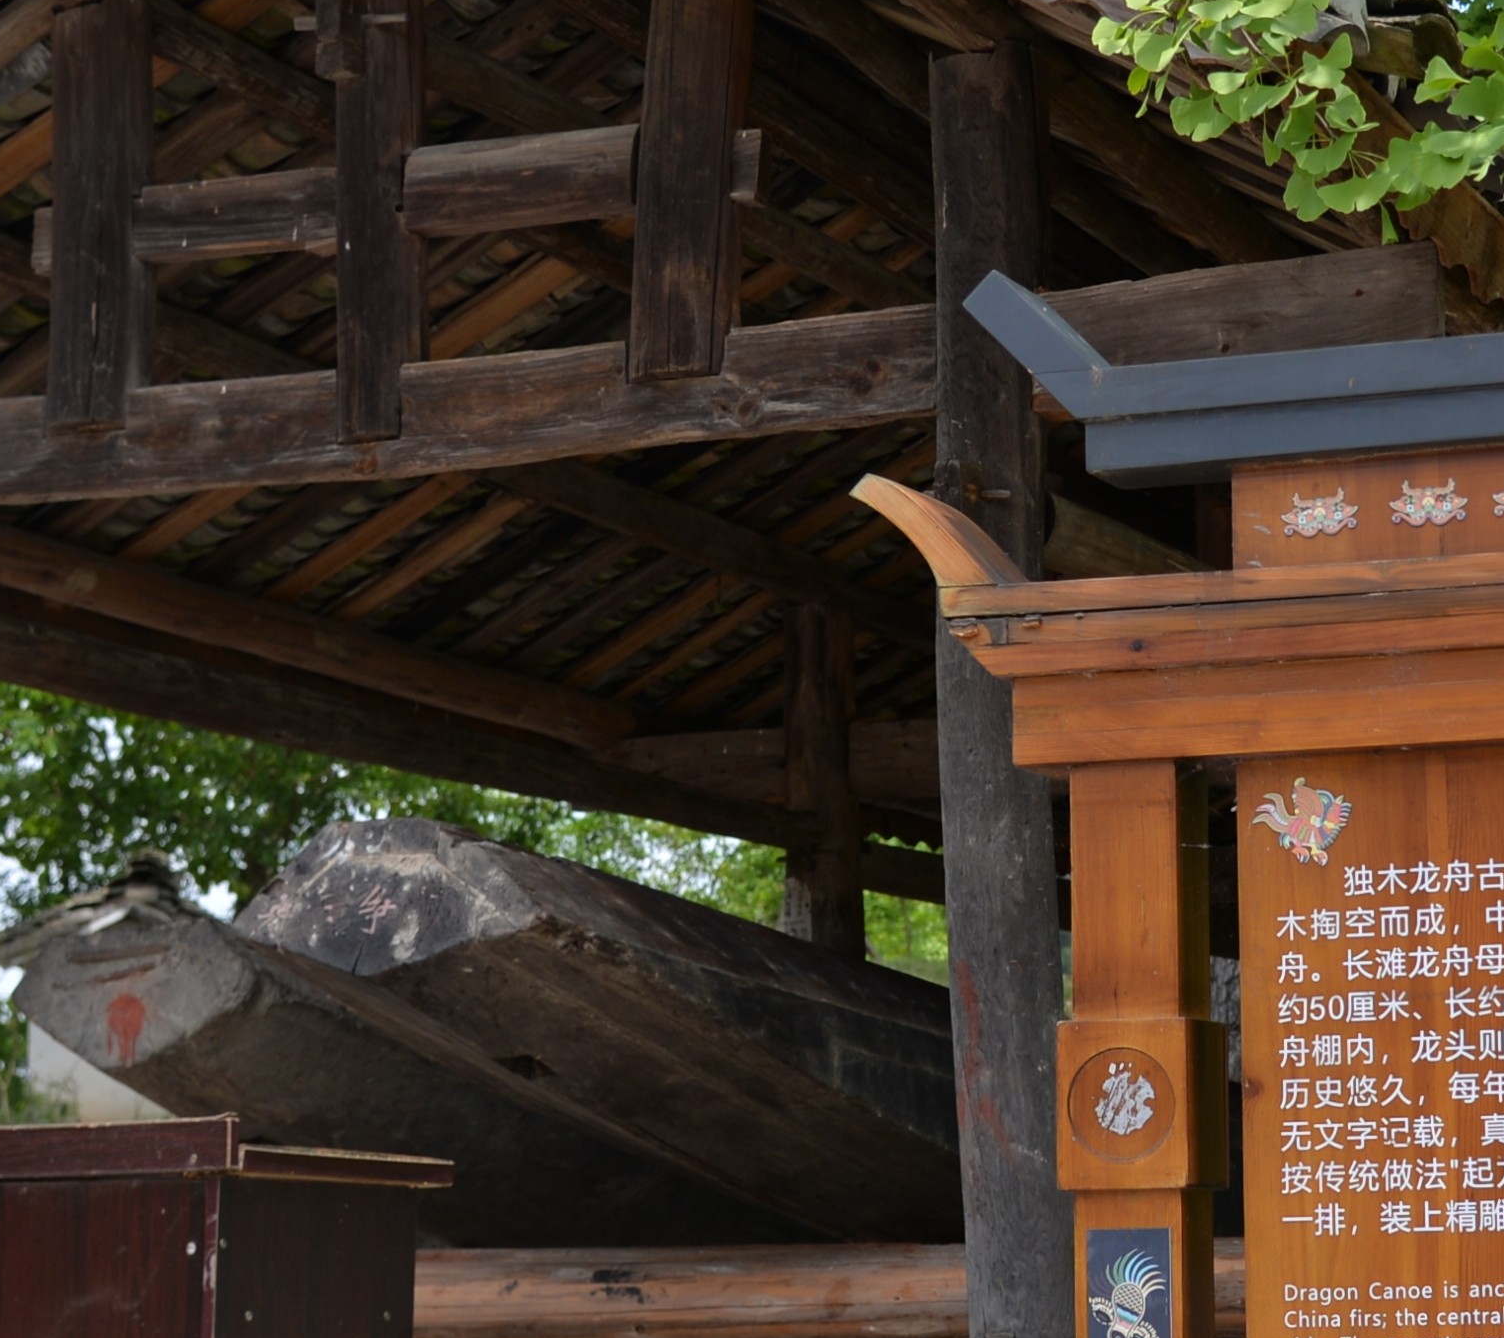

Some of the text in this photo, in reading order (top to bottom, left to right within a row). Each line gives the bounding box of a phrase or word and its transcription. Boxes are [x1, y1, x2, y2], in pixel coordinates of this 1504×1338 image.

[1284, 1283, 1359, 1306] Dragon
[1368, 1281, 1433, 1301] Canoe
[1443, 1279, 1460, 1299] is
[1283, 1309, 1341, 1329] China
[1349, 1308, 1387, 1329] firs;
[1394, 1307, 1429, 1327] the
